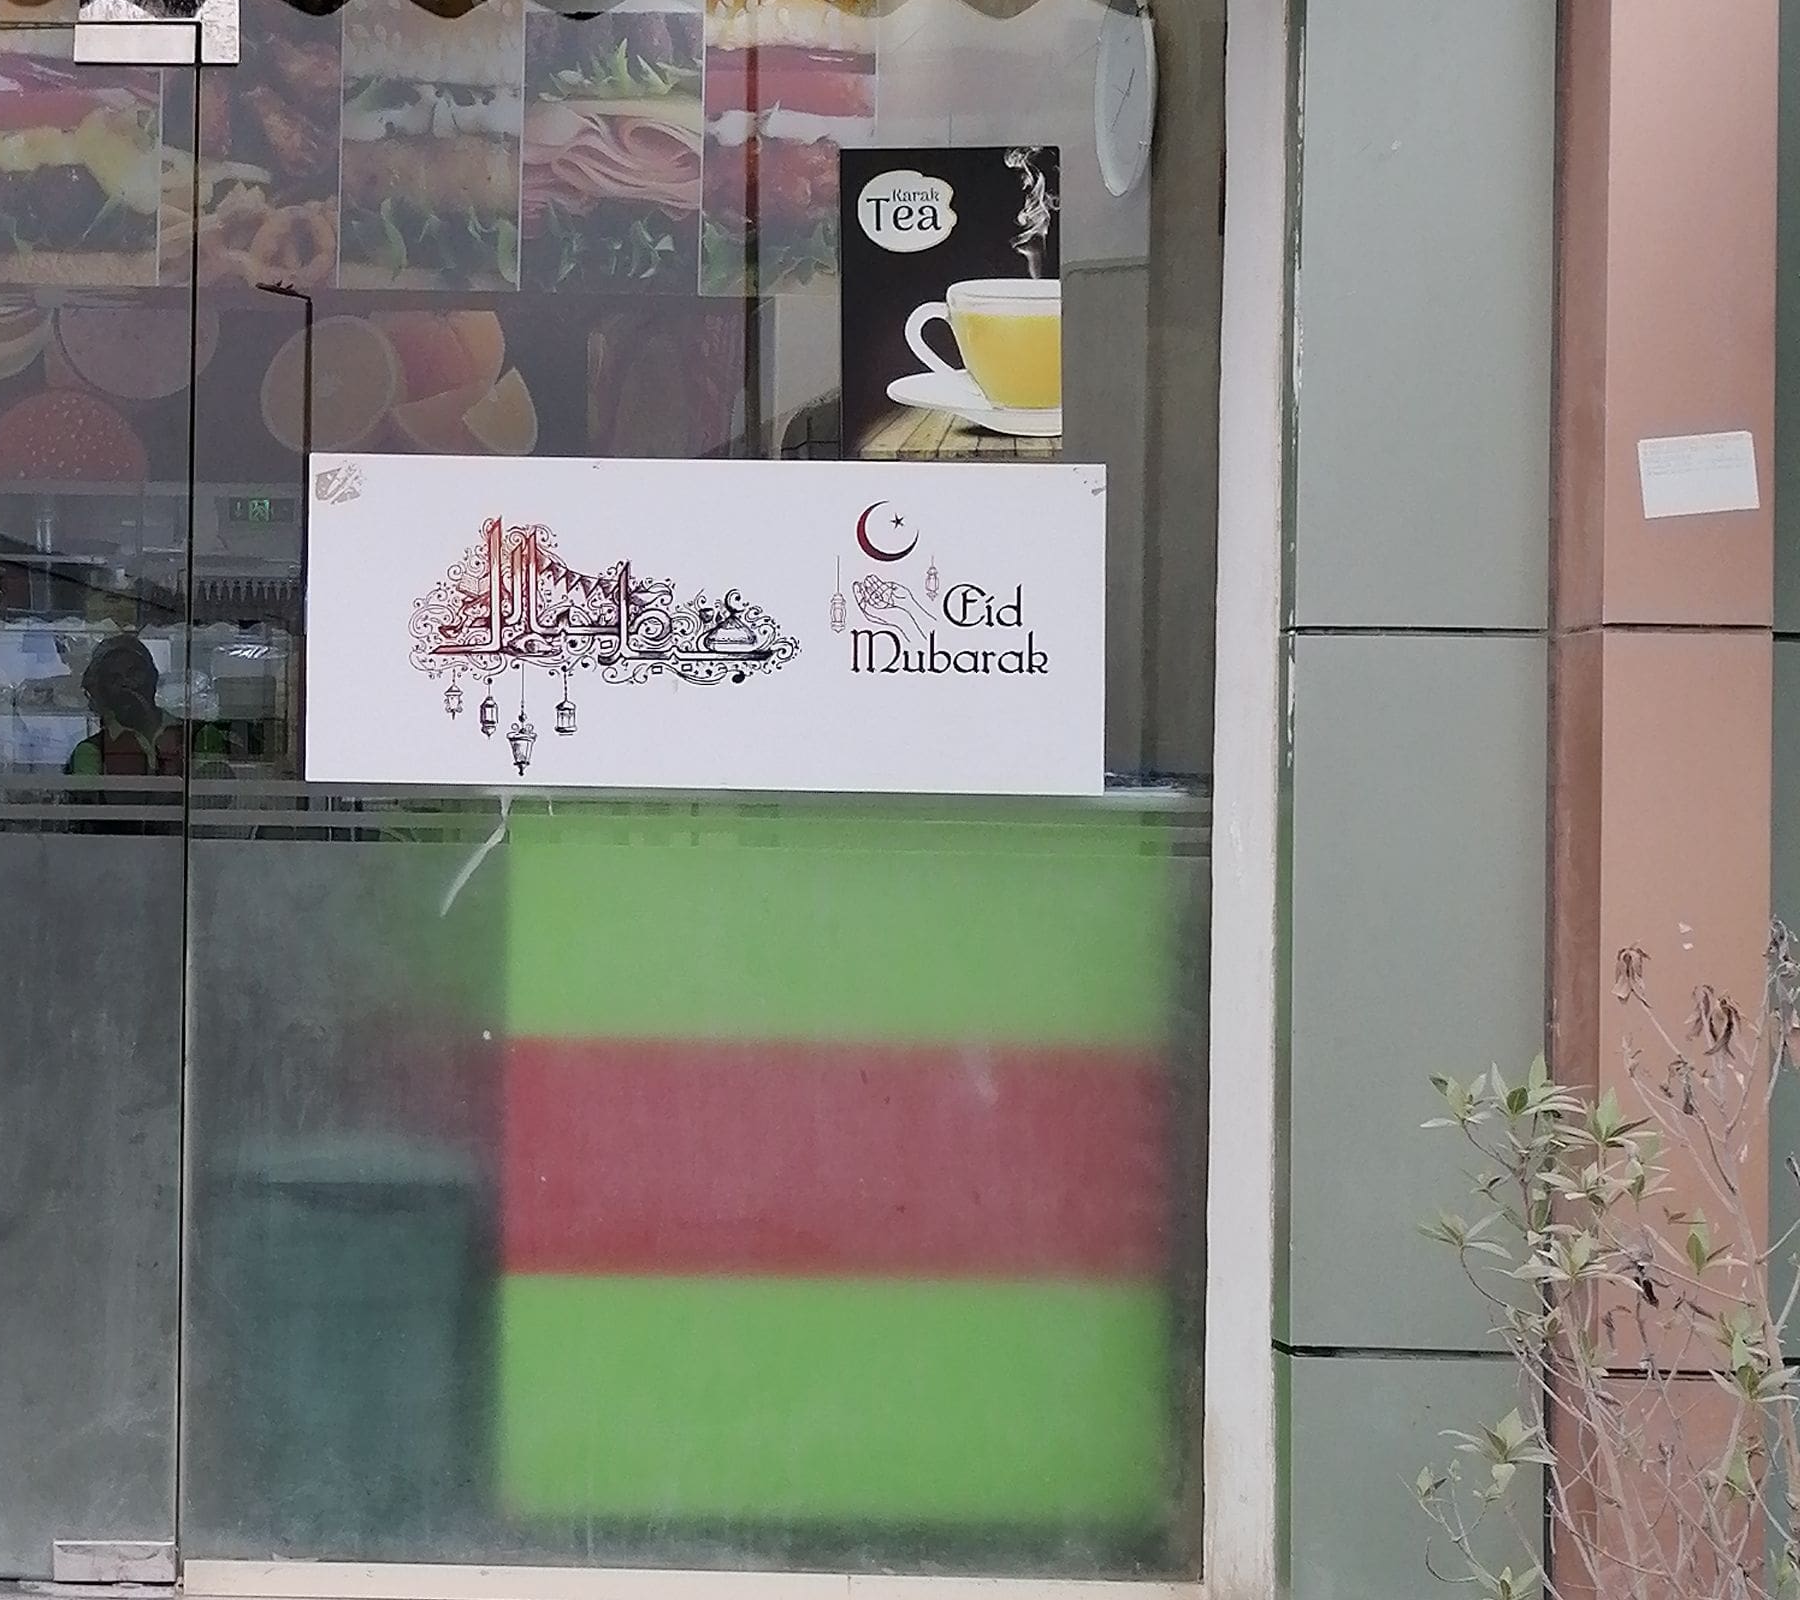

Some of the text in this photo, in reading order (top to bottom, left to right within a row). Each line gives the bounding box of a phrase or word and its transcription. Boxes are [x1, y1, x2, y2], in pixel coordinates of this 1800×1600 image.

[892, 187, 940, 202] Karak
[866, 198, 942, 232] Tea
[942, 583, 1024, 628] Eid
[850, 628, 1049, 675] Mubarak
